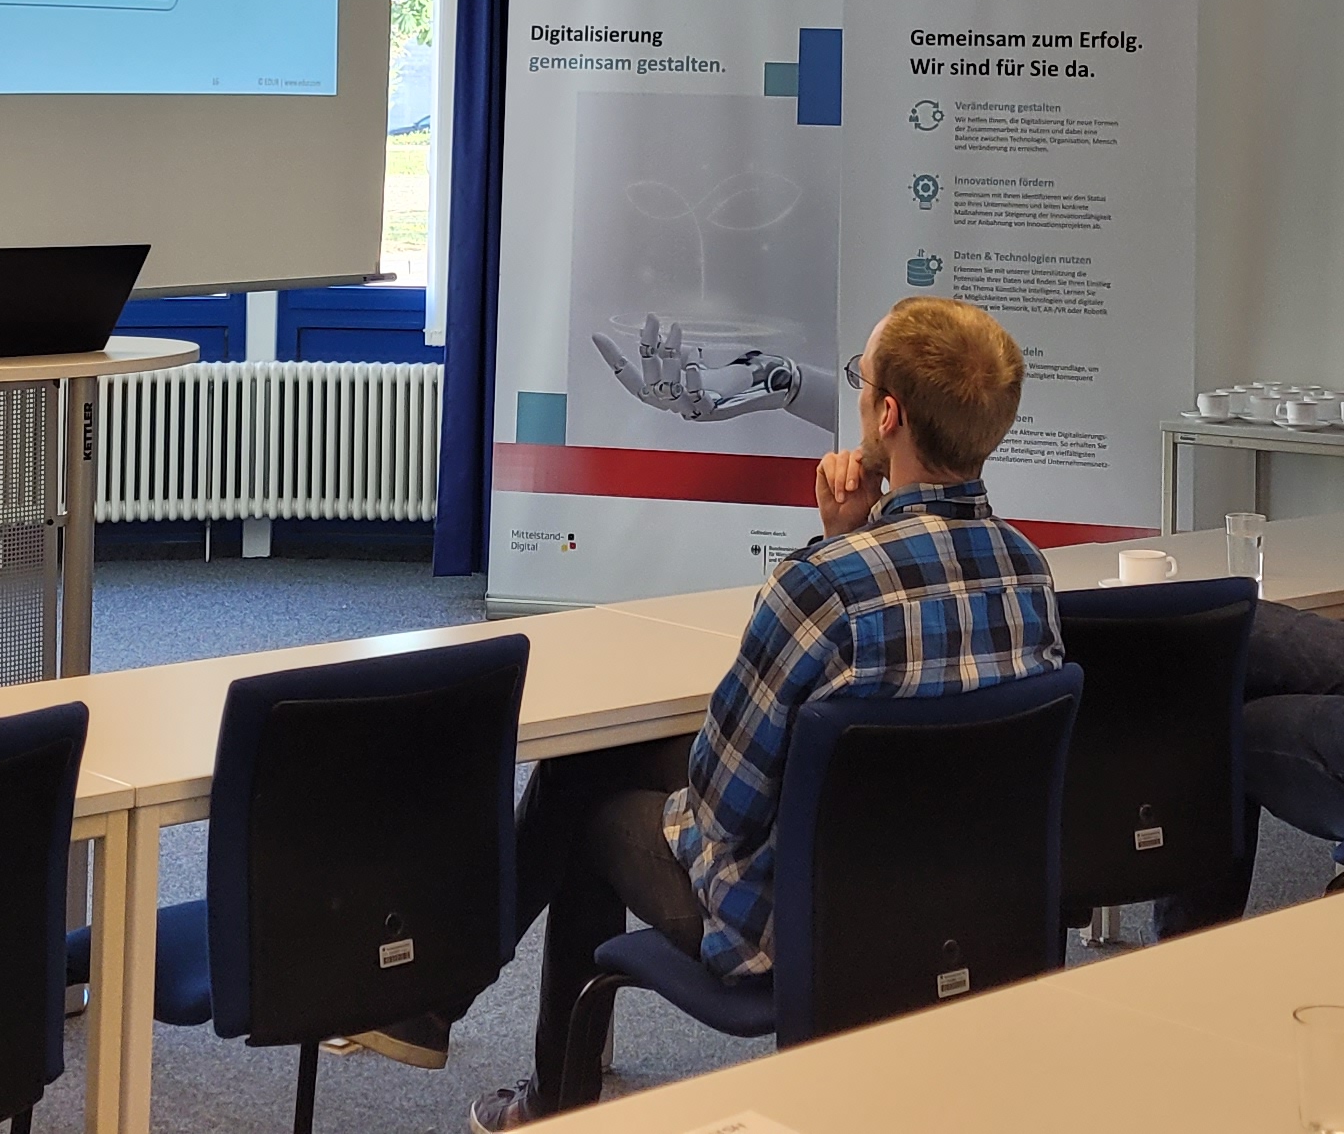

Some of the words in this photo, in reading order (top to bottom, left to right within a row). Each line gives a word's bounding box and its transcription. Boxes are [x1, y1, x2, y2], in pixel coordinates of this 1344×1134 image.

[531, 25, 663, 47] Digitalisierung
[910, 30, 1025, 47] Gemeinsam
[1032, 34, 1073, 48] zum
[1080, 31, 1143, 53] Erfolg.
[529, 54, 632, 72] gemeinsam
[636, 56, 726, 74] gestalten.
[910, 58, 945, 75] Wir
[950, 58, 990, 76] sind
[996, 59, 1024, 76] für
[1030, 60, 1059, 77] Sie
[1065, 60, 1095, 78] da.
[955, 101, 1016, 113] Veränderung
[1018, 103, 1061, 113] gestalten
[1021, 118, 1064, 126] Digitalisierung
[955, 176, 1016, 186] Innovationen
[1019, 177, 1053, 187] fördern
[954, 251, 981, 260] Daten
[984, 252, 992, 261] &
[994, 252, 1056, 264] Technologien
[1059, 255, 1091, 264] nutzen
[83, 403, 92, 460] KETTLER
[512, 530, 564, 540] Mittelstand-
[511, 542, 537, 552] Digital
